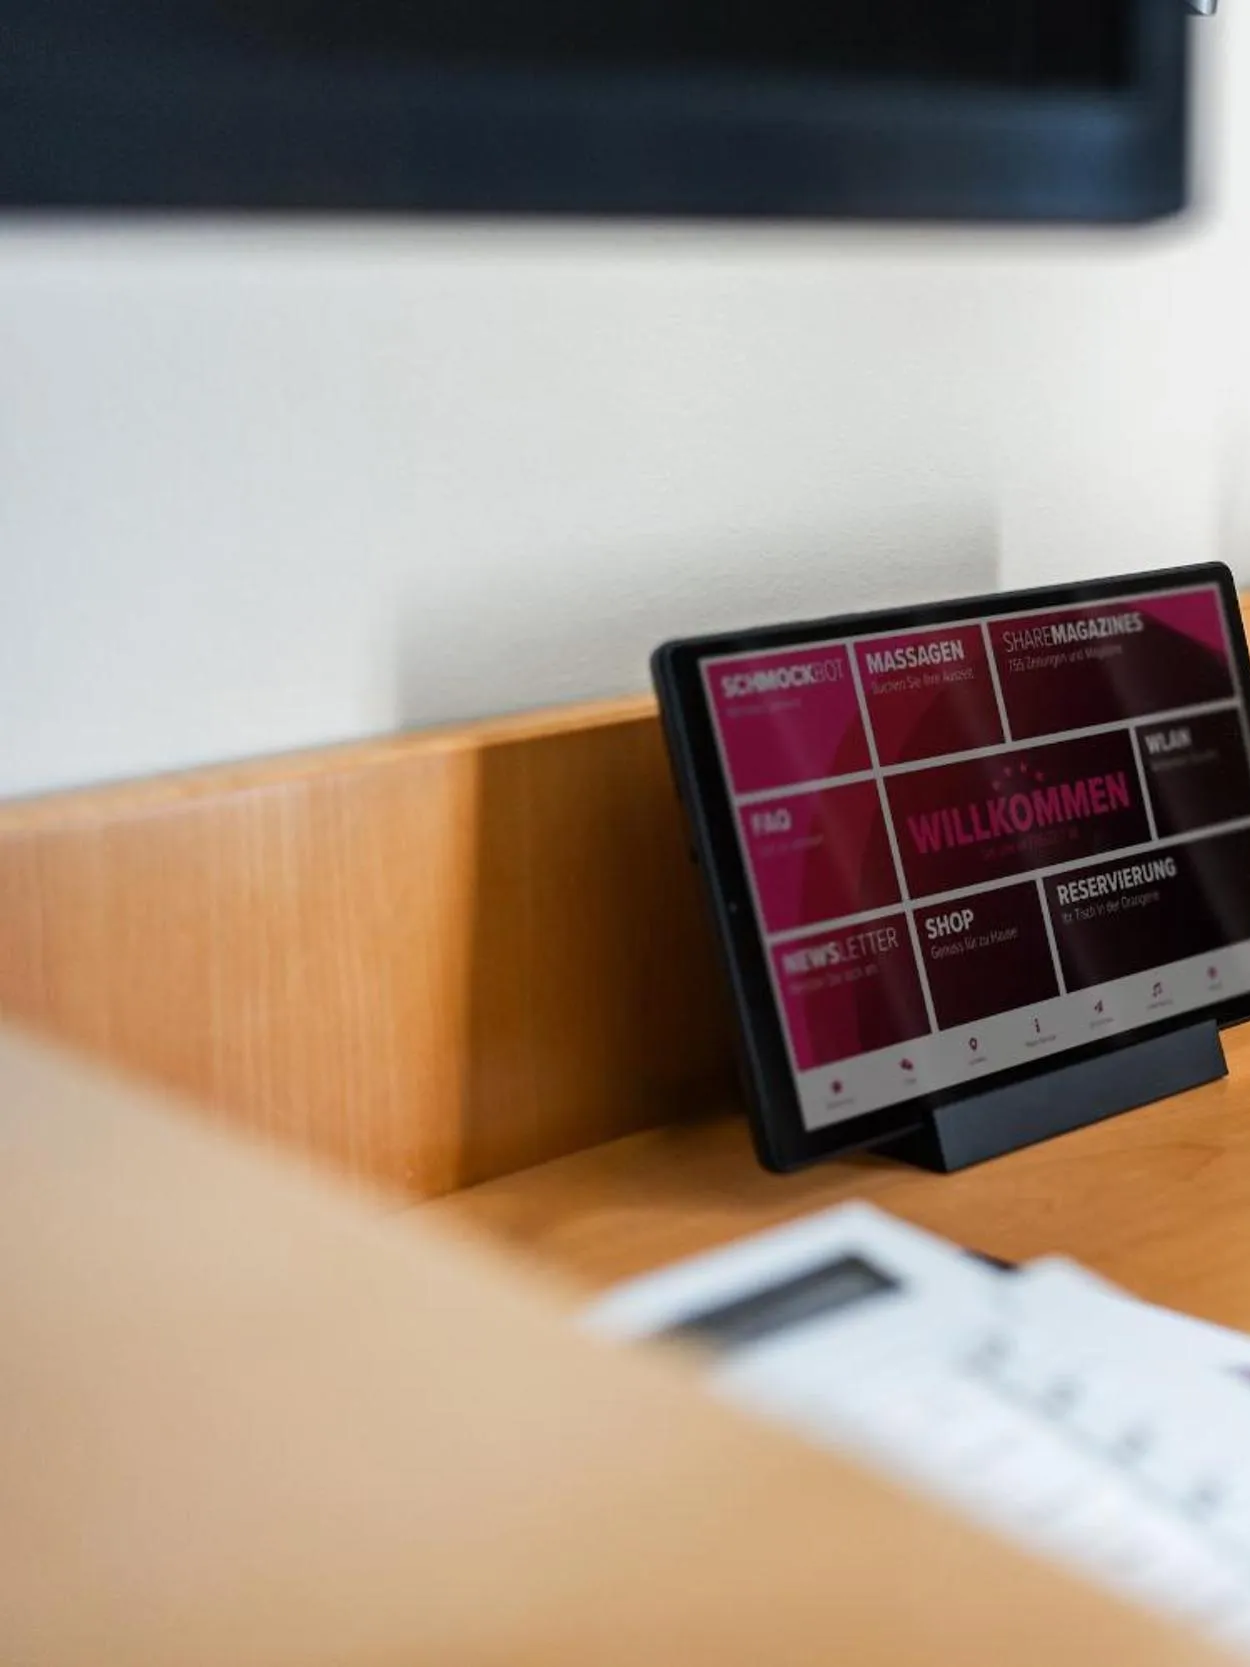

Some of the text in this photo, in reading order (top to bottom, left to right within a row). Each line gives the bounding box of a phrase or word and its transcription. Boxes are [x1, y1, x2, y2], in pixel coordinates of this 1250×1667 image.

[1002, 611, 1144, 653] SHAREMAGAZINES
[865, 640, 965, 674] MASSAGEN
[907, 771, 1132, 854] WILLKOMMEN
[1056, 856, 1178, 906] RESERVIERUNG
[925, 908, 974, 939] SHOP
[782, 926, 899, 974] NEWSLETTER
